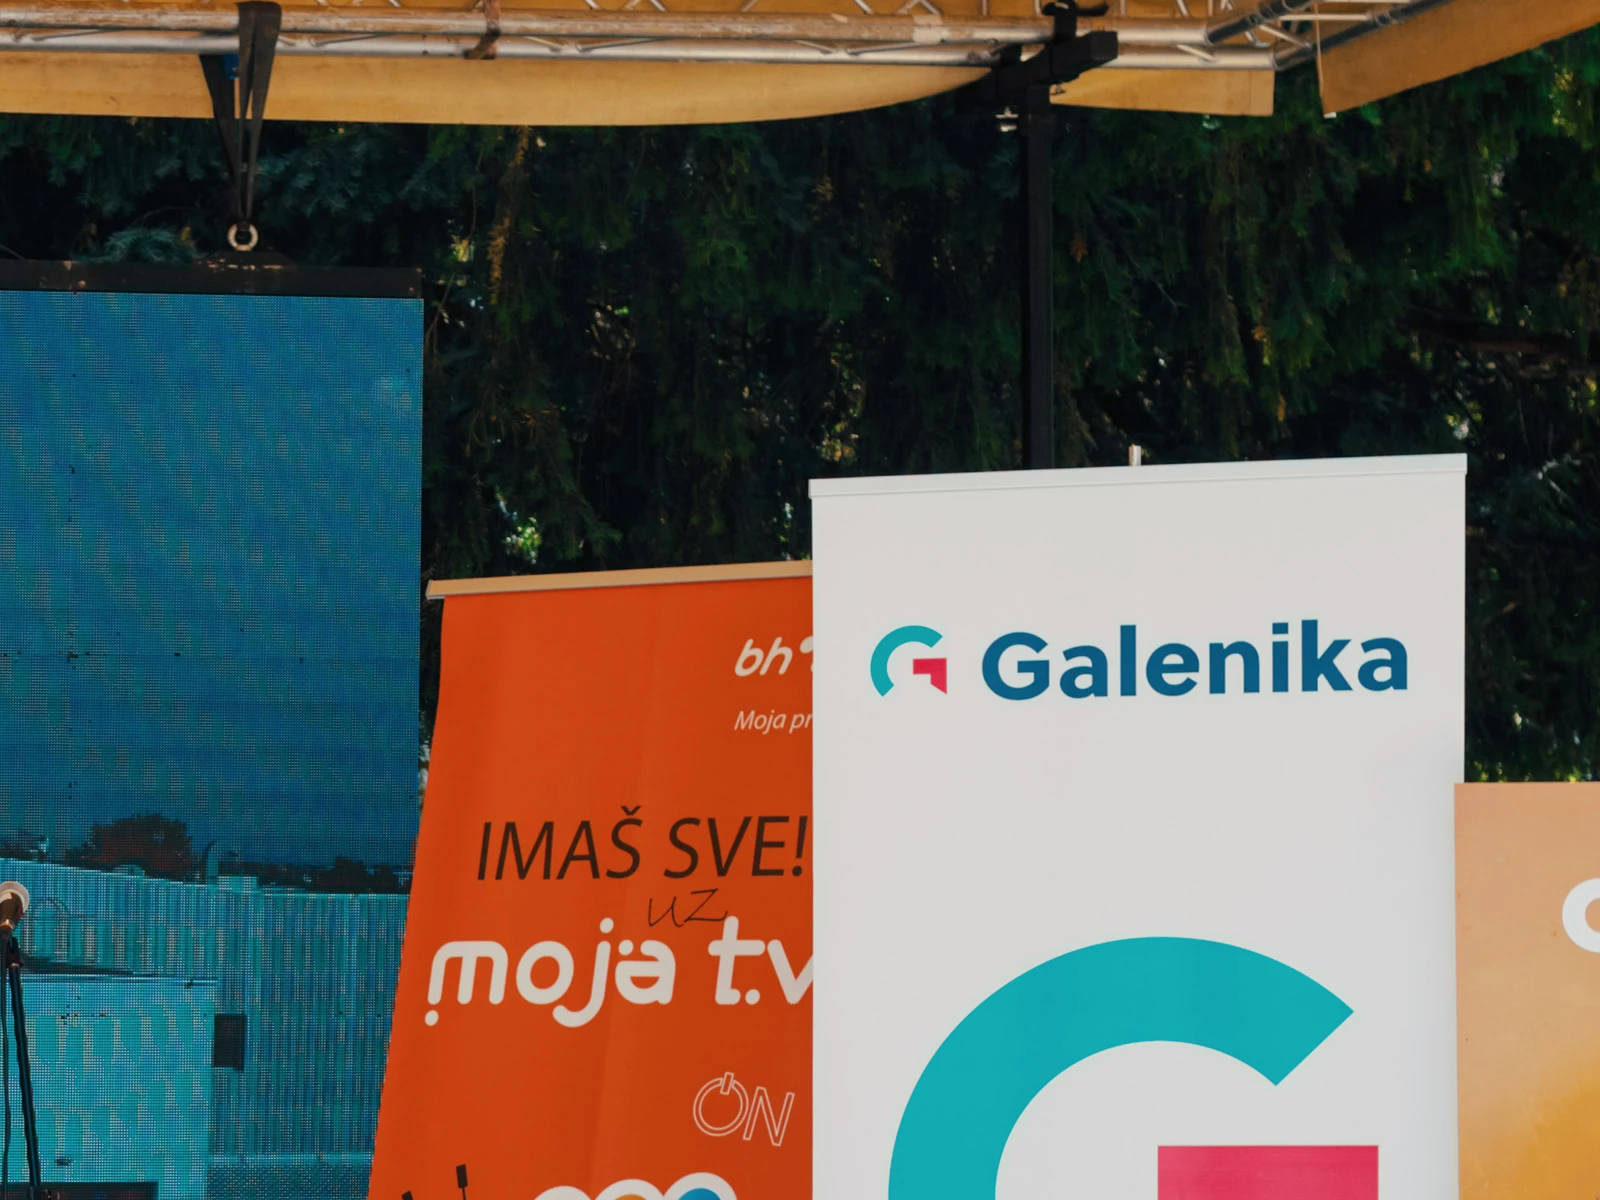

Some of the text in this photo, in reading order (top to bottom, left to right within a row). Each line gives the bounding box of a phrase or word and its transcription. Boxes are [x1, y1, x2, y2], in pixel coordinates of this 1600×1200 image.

[981, 619, 1409, 701] Galenika
[733, 709, 787, 735] Moja
[476, 805, 809, 881] IMAŠ SVE!
[424, 917, 677, 1028] moja
